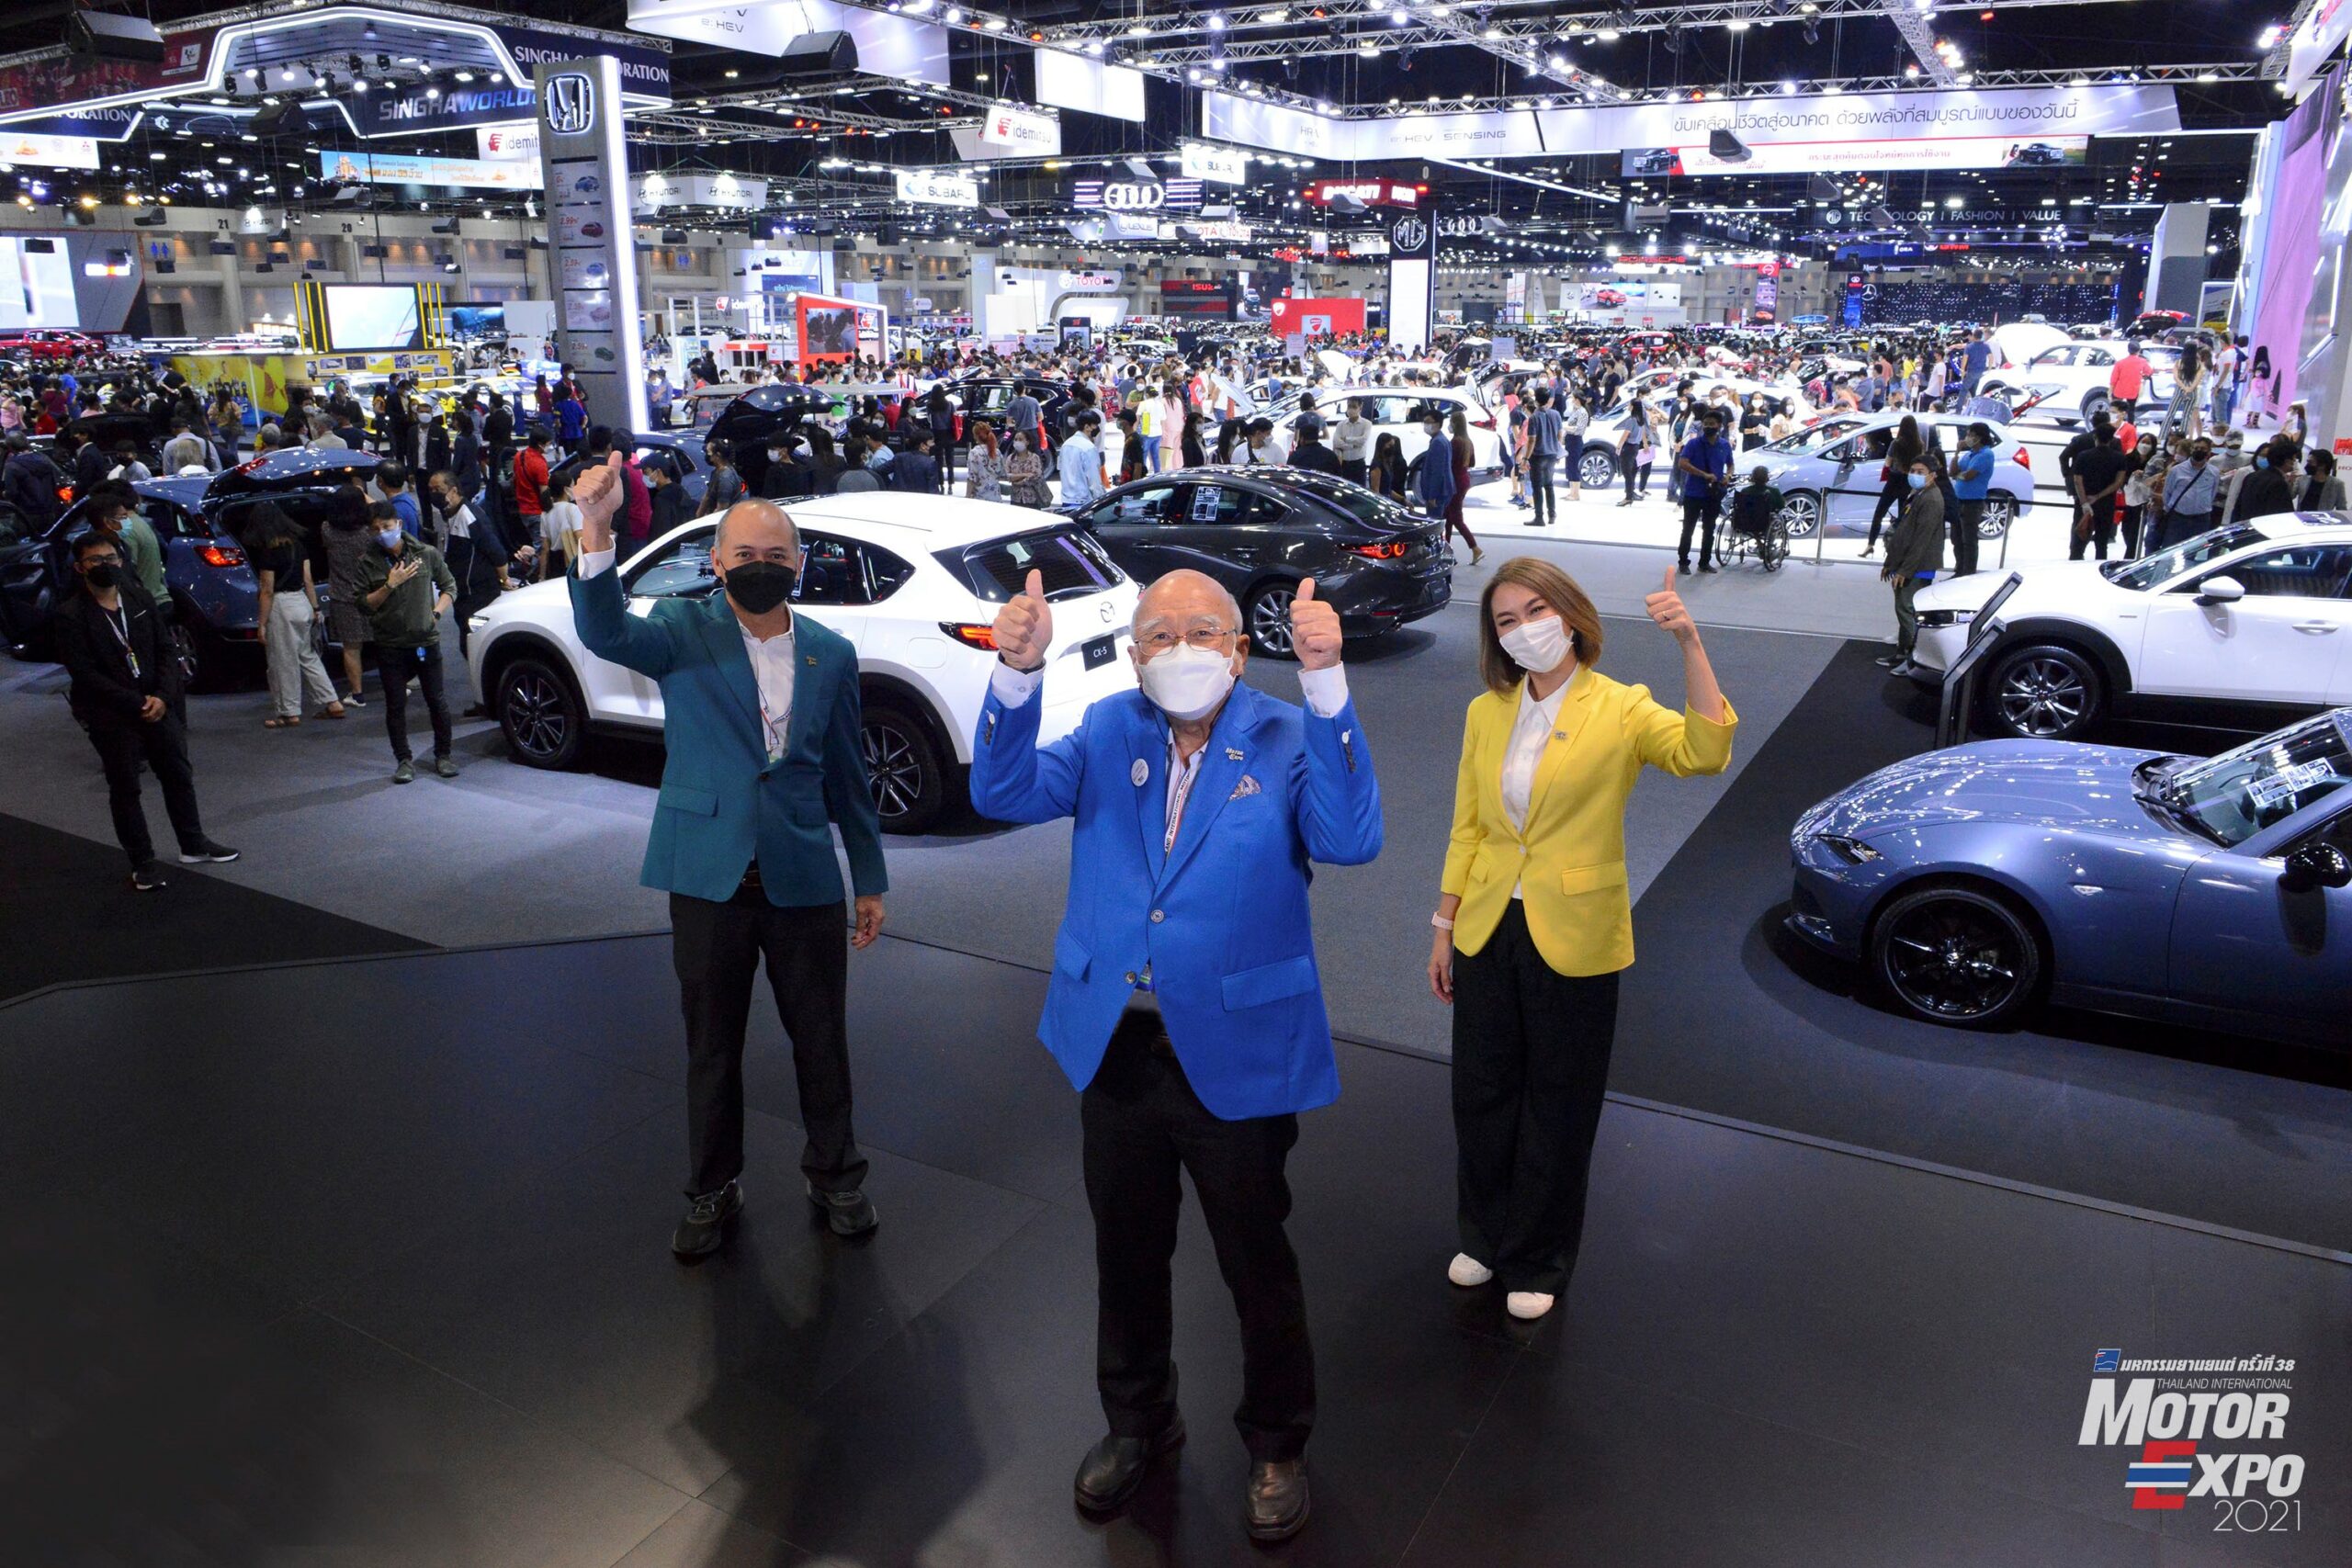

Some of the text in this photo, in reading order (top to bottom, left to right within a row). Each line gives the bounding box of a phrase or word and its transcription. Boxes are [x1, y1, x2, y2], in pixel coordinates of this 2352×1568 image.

[514, 46, 571, 65] SINGHA
[1674, 98, 2080, 132] ขับเคลื่อนชีวิตสู่อนาคต ด้วยพลังที่สมบูรณ์แบบของวันนี้
[1443, 130, 1507, 141] SENSING
[1849, 210, 1935, 221] TECOLOGY
[1951, 210, 2006, 221] FASHION
[2022, 210, 2062, 221] VALUE
[218, 219, 229, 229] 21
[342, 222, 353, 233] 20
[1092, 646, 1108, 659] CX-5
